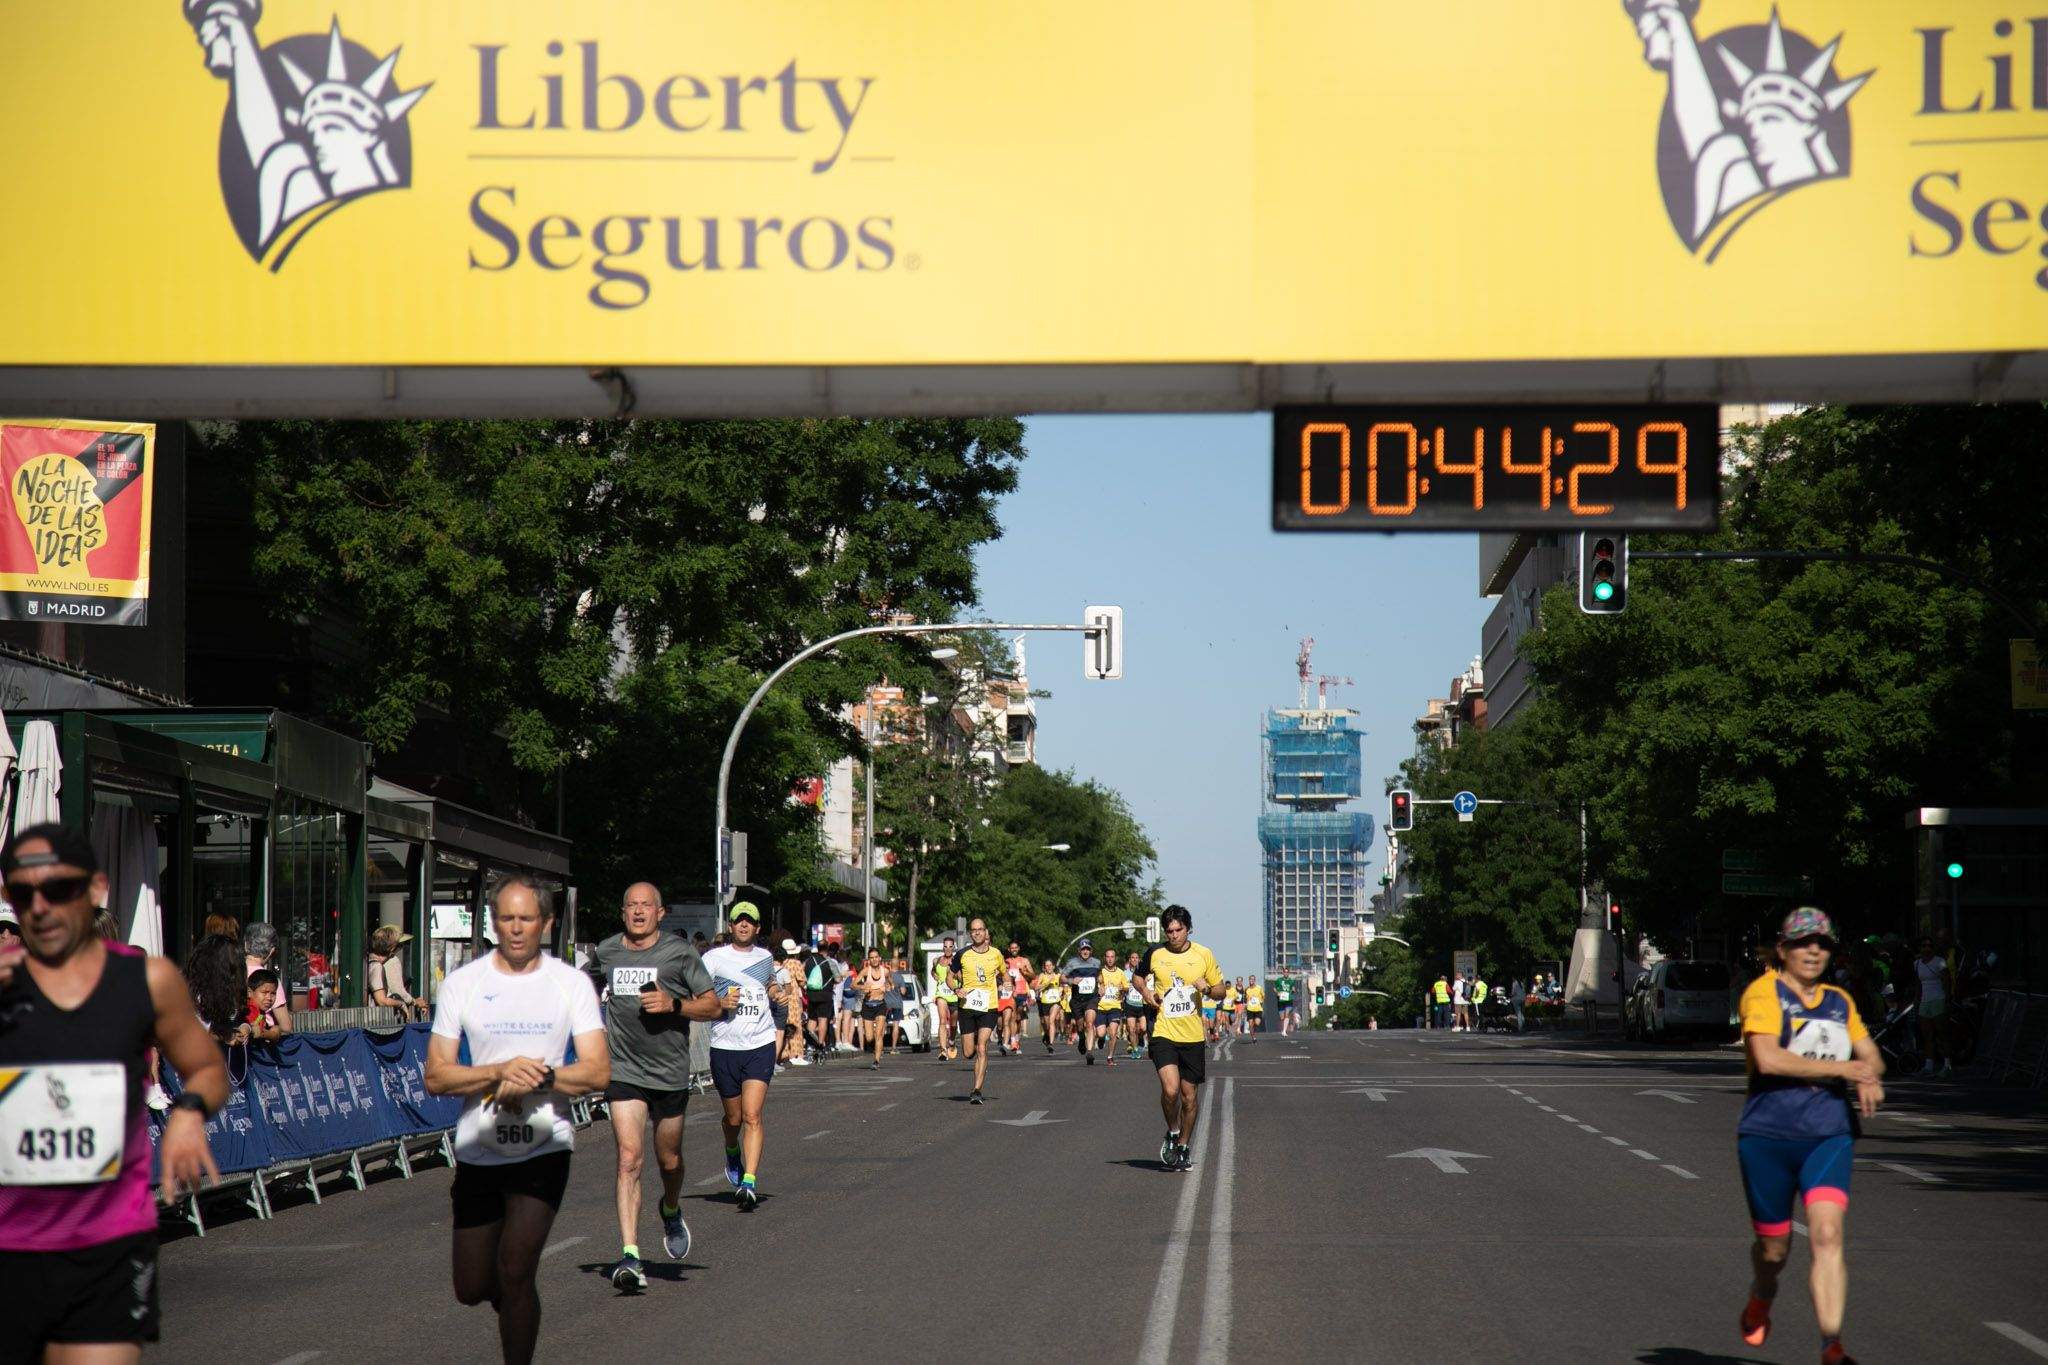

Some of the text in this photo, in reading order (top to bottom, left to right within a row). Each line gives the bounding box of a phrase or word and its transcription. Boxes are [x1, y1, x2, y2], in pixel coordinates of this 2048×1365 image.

[470, 39, 876, 175] Liberty
[1907, 168, 2048, 292] Se
[41, 458, 66, 477] LA
[1301, 421, 1688, 516] 00:44:29
[17, 466, 92, 505] NOCHE
[26, 503, 101, 531] DE LAS
[36, 528, 102, 568] IDEAS
[47, 602, 106, 618] MADRID
[1170, 1001, 1191, 1013] 2678
[527, 1022, 553, 1030] CASE
[17, 1126, 96, 1161] 4318
[495, 1124, 534, 1145] 560
